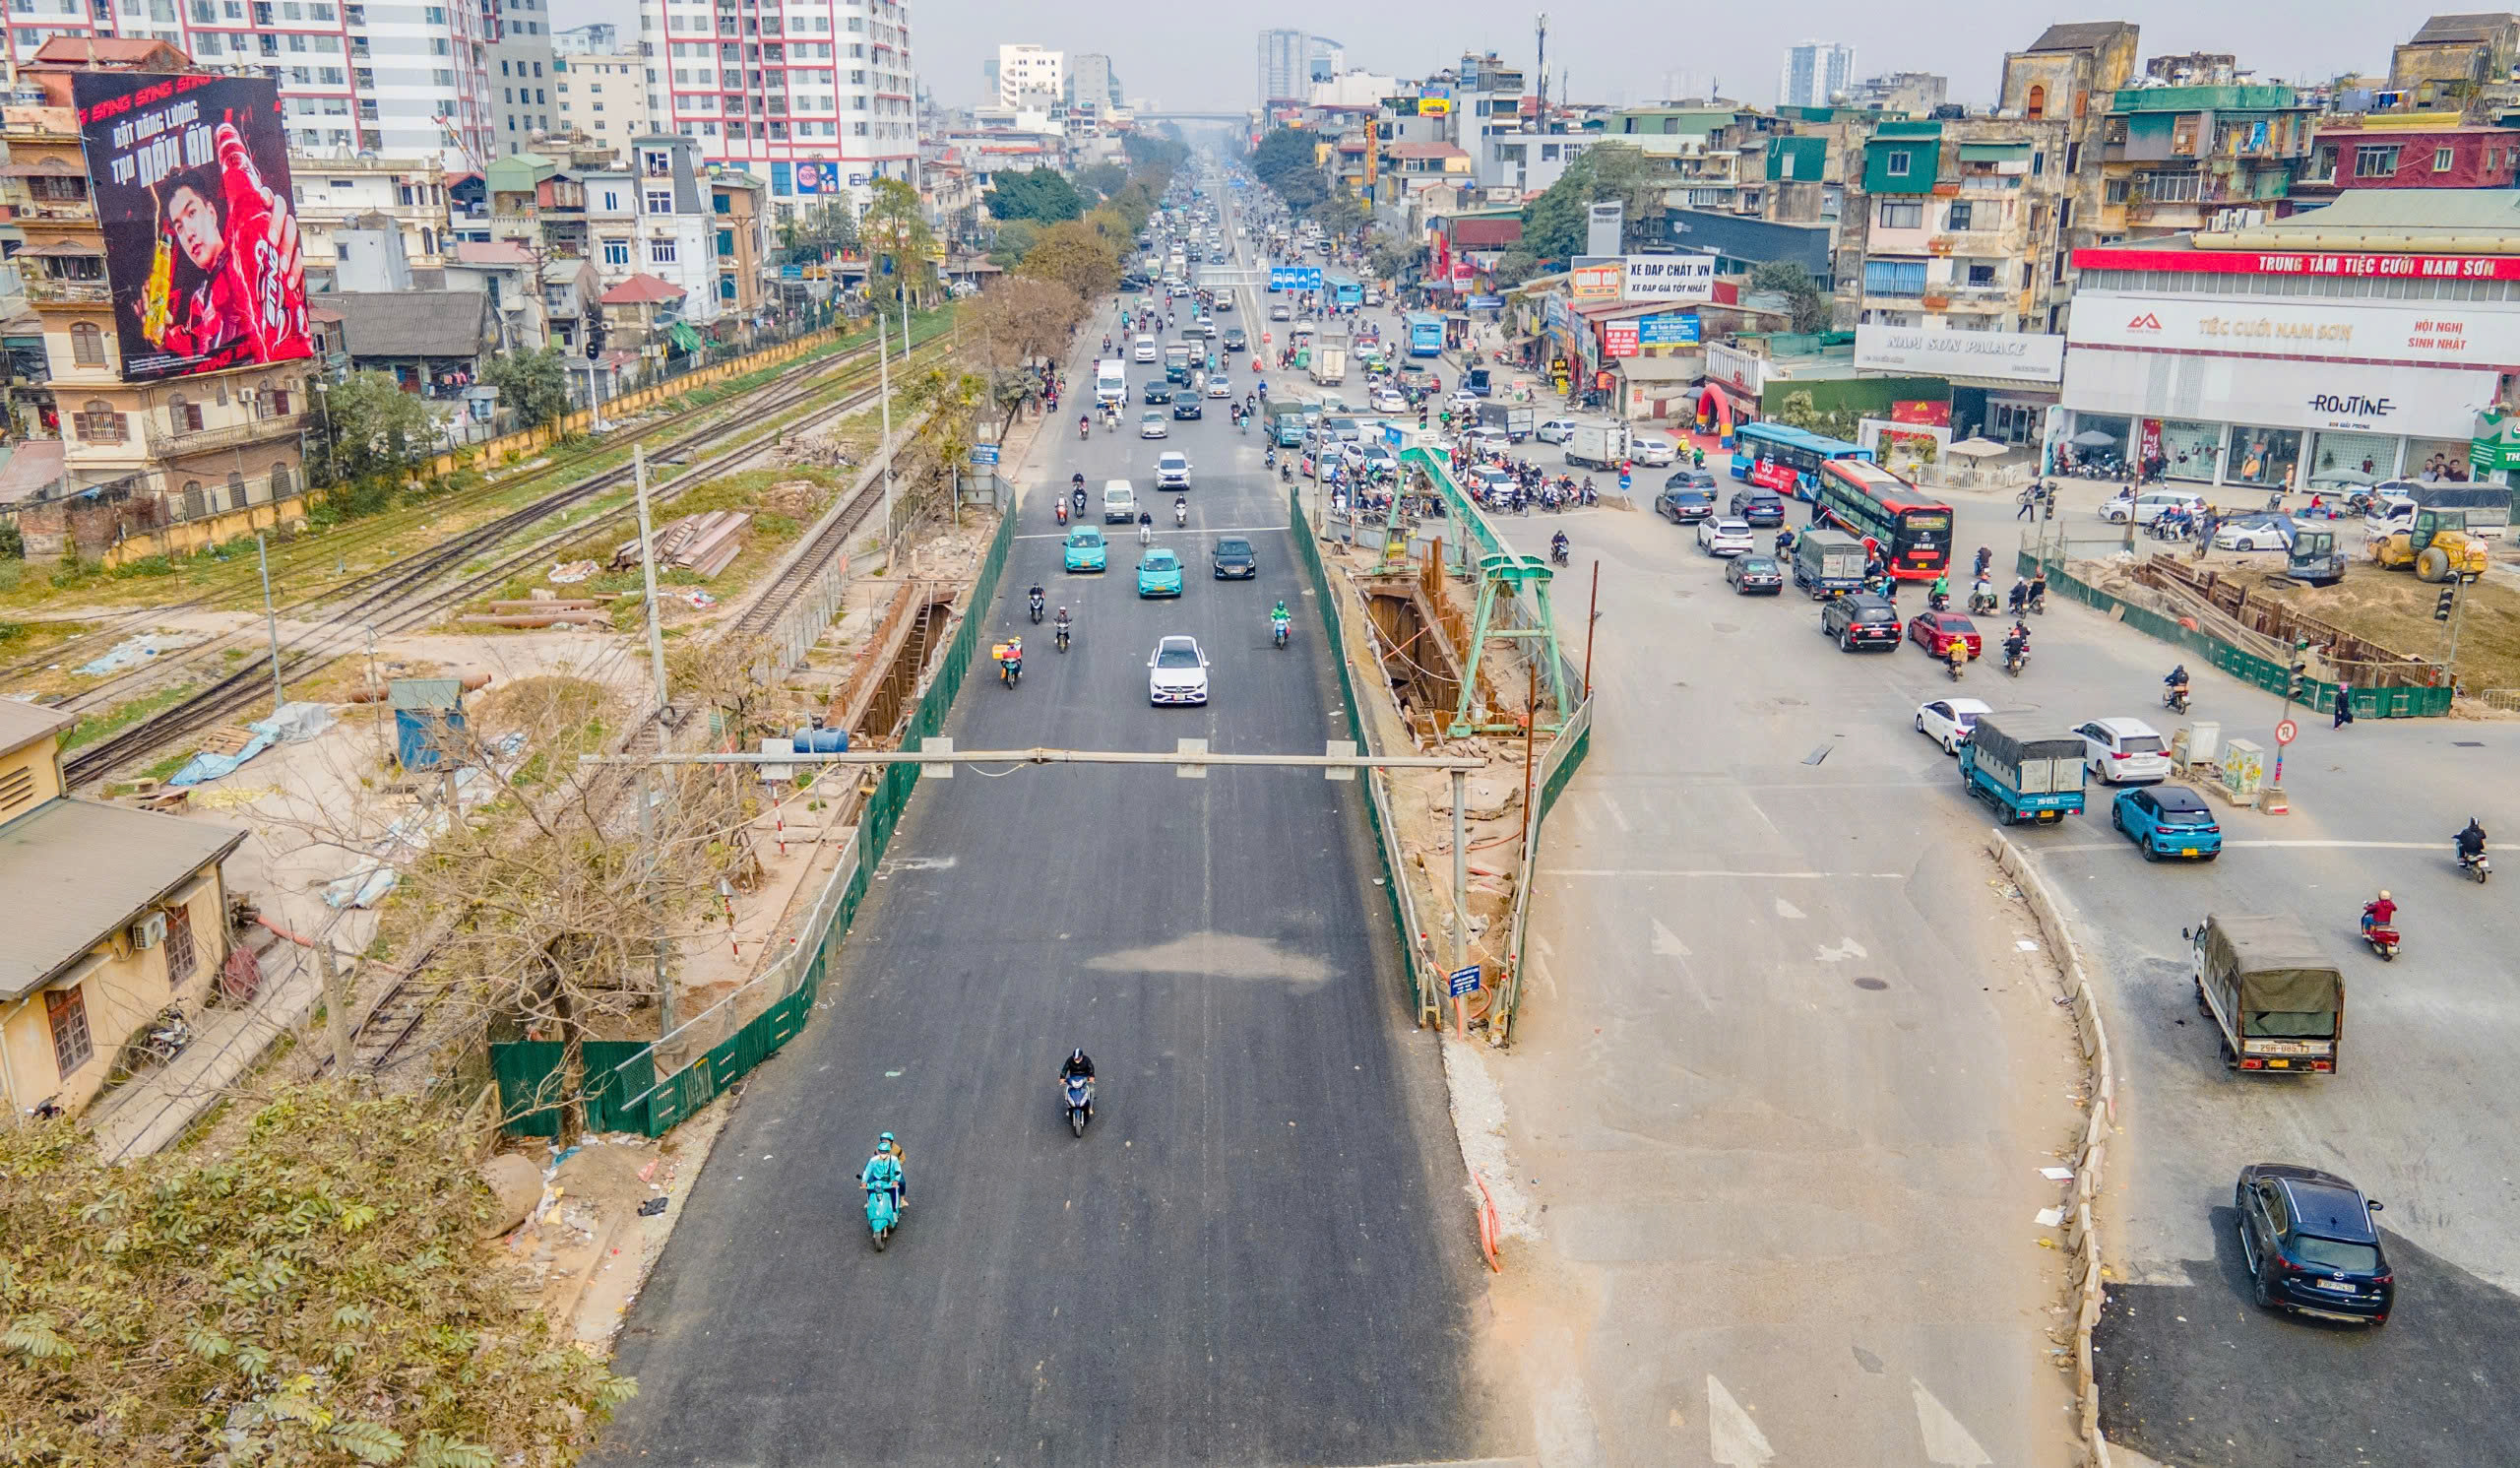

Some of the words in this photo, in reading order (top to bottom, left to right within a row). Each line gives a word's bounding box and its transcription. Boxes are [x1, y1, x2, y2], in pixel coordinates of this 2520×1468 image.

[1630, 264, 1642, 276] XE
[2259, 256, 2303, 272] TRUNG
[2309, 253, 2339, 273] TÂM
[2345, 256, 2375, 277] TIỆC
[2379, 256, 2415, 275] CƯỚI
[2422, 260, 2458, 277] NAM
[2462, 258, 2496, 277] SƠN
[1631, 284, 1641, 292] XE
[2276, 322, 2313, 340] NAM
[2415, 320, 2433, 333] HỘI
[2436, 322, 2464, 335] NGHỊ
[1887, 336, 1922, 350] NAM
[1965, 341, 2029, 357] PALACE
[2408, 338, 2435, 350] SINH
[2437, 338, 2467, 351] NHẬT
[1762, 456, 1774, 474] 5G
